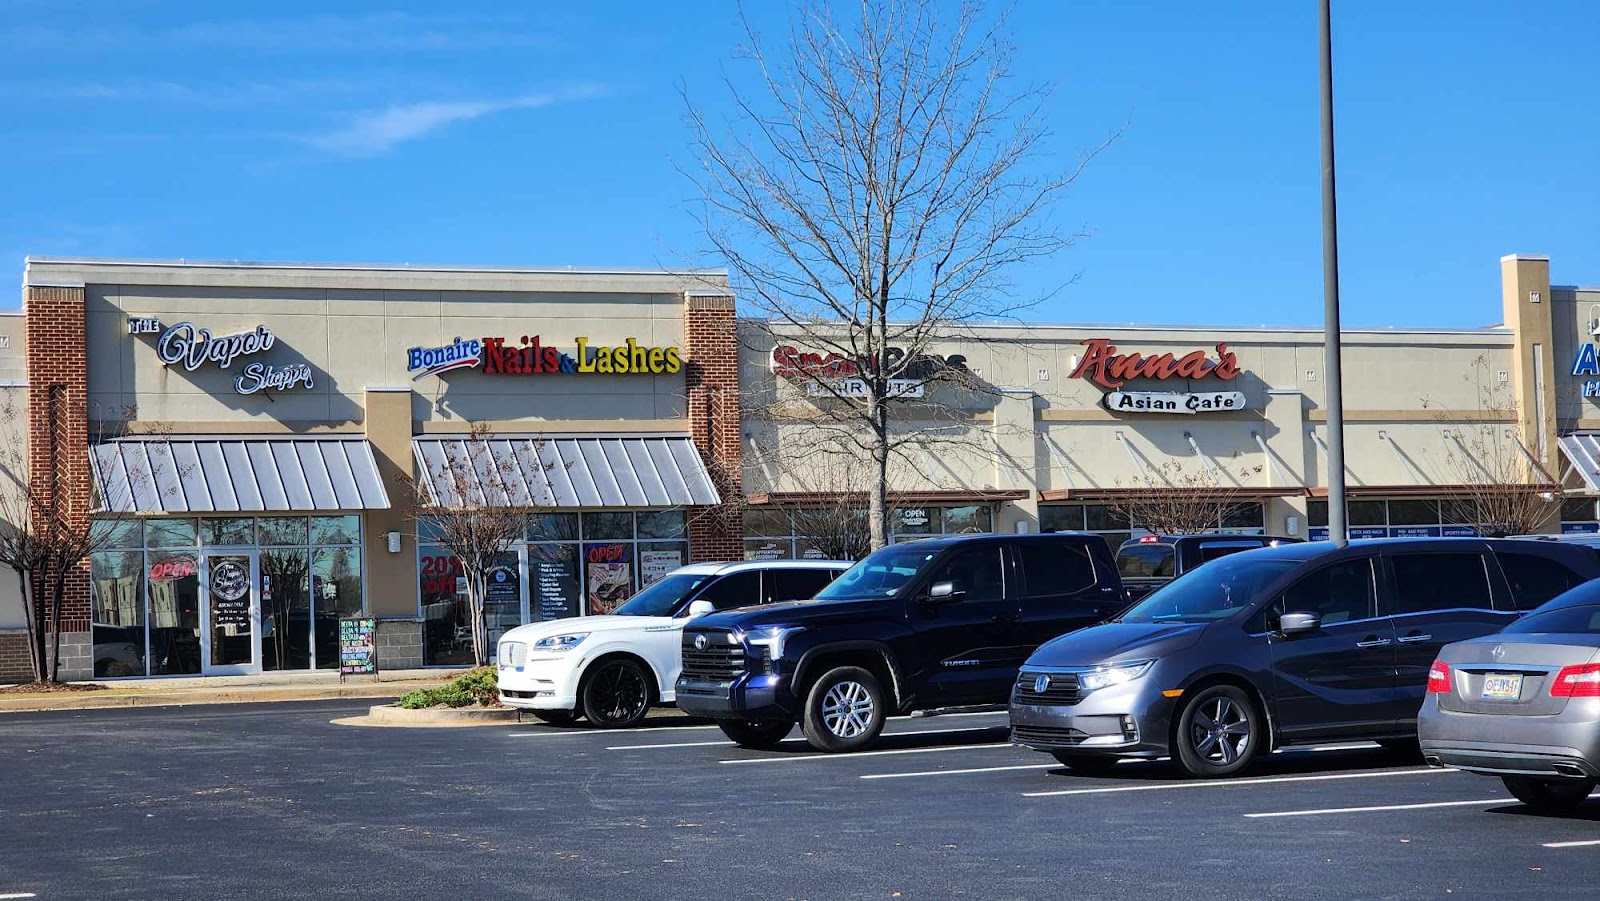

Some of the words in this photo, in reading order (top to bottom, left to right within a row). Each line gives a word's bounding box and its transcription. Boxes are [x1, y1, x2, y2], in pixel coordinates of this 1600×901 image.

[128, 316, 160, 334] THE
[156, 321, 275, 371] Vapor
[408, 336, 481, 372] Bonaire
[482, 335, 559, 374] Nails
[560, 353, 577, 374] &
[576, 336, 681, 374] Lashes
[1067, 338, 1241, 388] Anna's
[1118, 394, 1176, 410] Asian
[904, 509, 926, 518] OPEN
[588, 543, 624, 563] OPEN
[150, 562, 190, 578] OPEN
[425, 574, 456, 594] off
